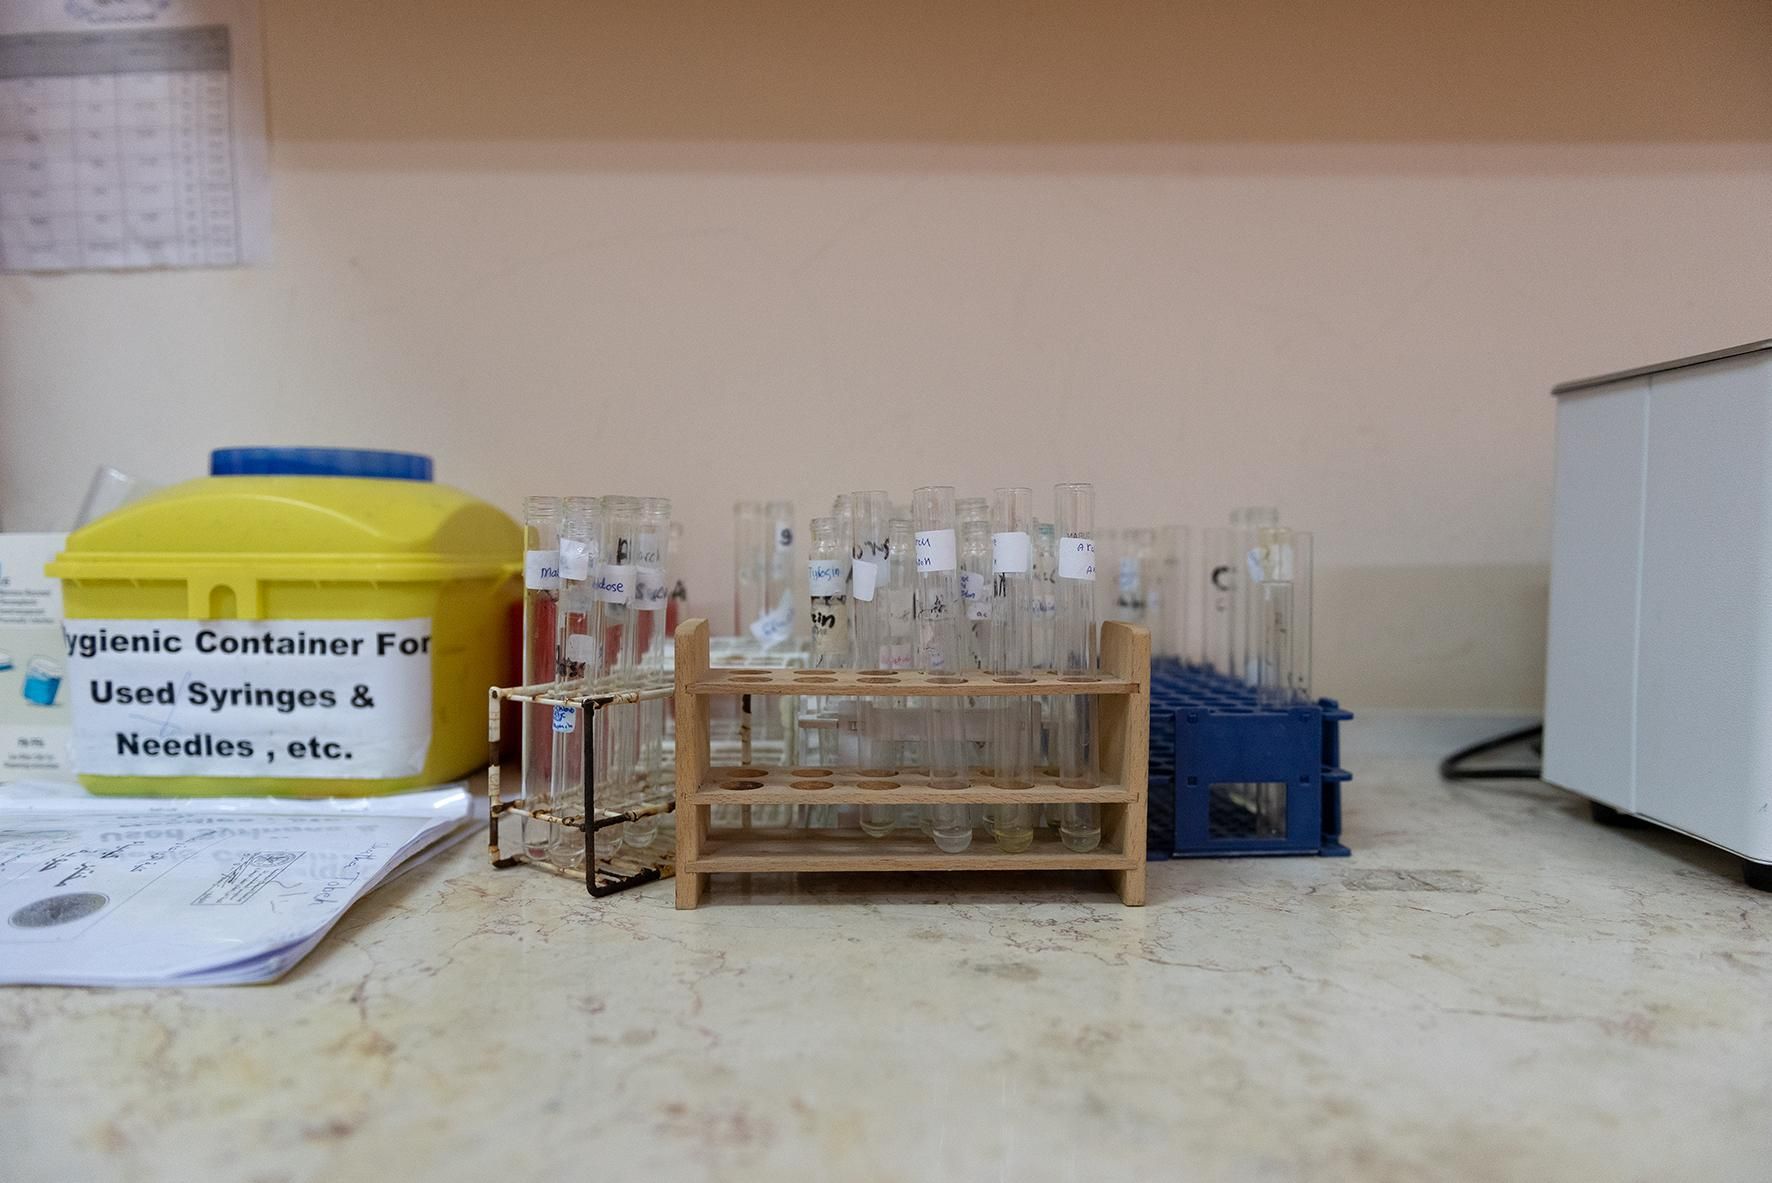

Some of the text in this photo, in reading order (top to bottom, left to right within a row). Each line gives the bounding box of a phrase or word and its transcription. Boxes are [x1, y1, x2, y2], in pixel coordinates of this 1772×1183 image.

[63, 628, 432, 657] ygienic Container For
[90, 681, 375, 713] Used Syringes &
[116, 732, 254, 758] Needles
[287, 736, 353, 759] etc.
